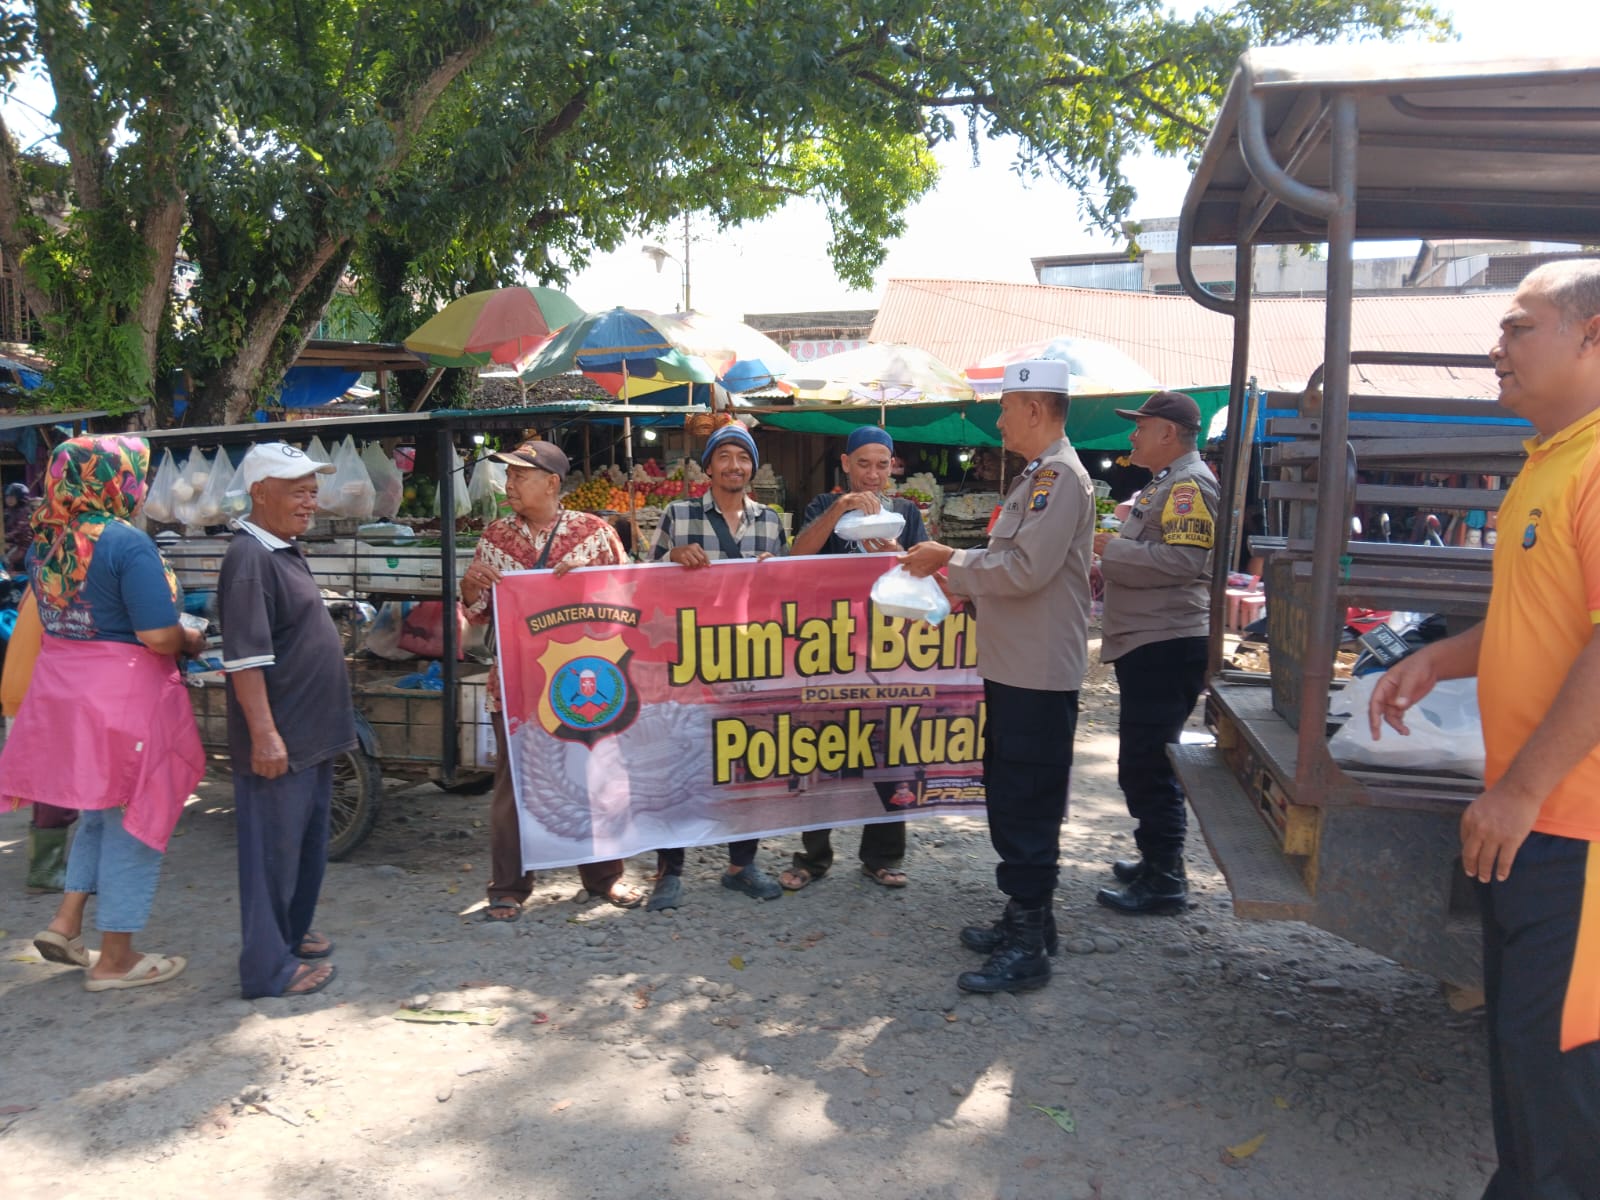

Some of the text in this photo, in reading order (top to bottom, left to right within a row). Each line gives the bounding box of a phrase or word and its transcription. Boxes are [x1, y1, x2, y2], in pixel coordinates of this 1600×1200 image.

[530, 606, 636, 632] SUMATERA UTARA
[670, 600, 856, 686] Jum'at
[806, 686, 932, 701] POLSEK KUALA
[713, 710, 876, 785] Polsek
